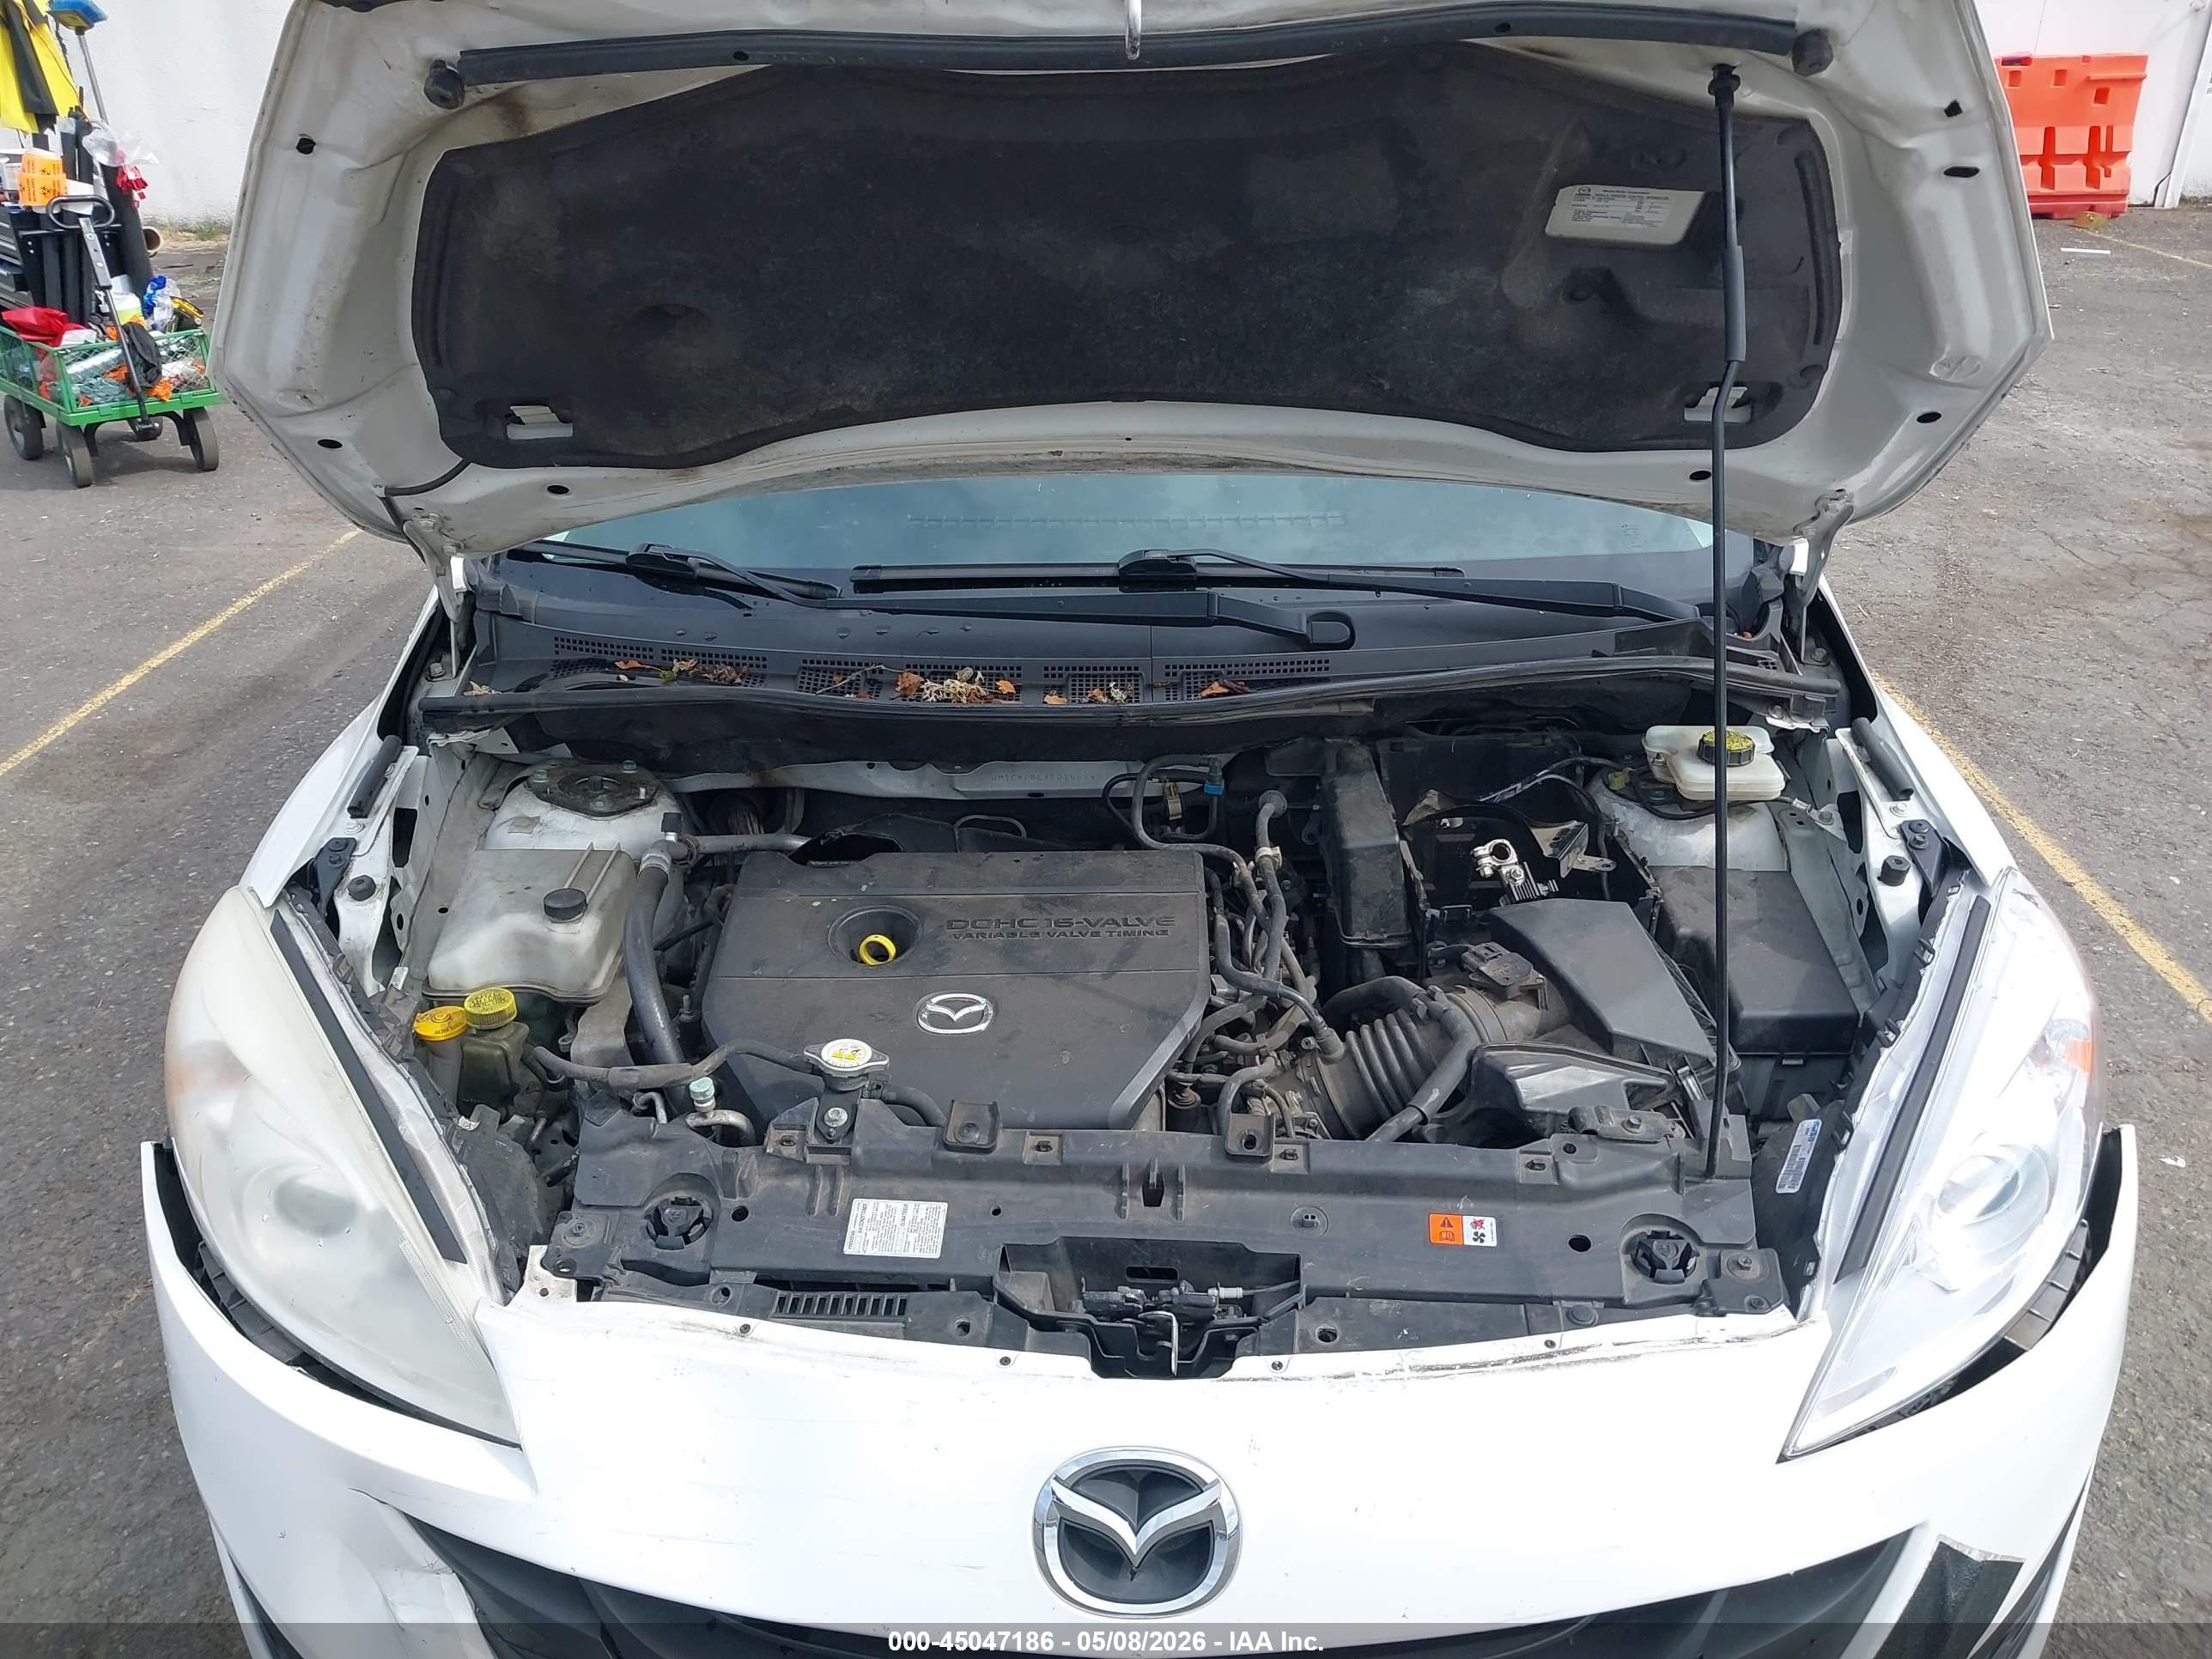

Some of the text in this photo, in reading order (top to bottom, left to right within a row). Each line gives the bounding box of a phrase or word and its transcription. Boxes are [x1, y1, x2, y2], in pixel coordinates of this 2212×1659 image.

[946, 916, 1176, 930] DOHC 16-VALVE
[952, 929, 1169, 940] VARIABLE VALVE TIMING
